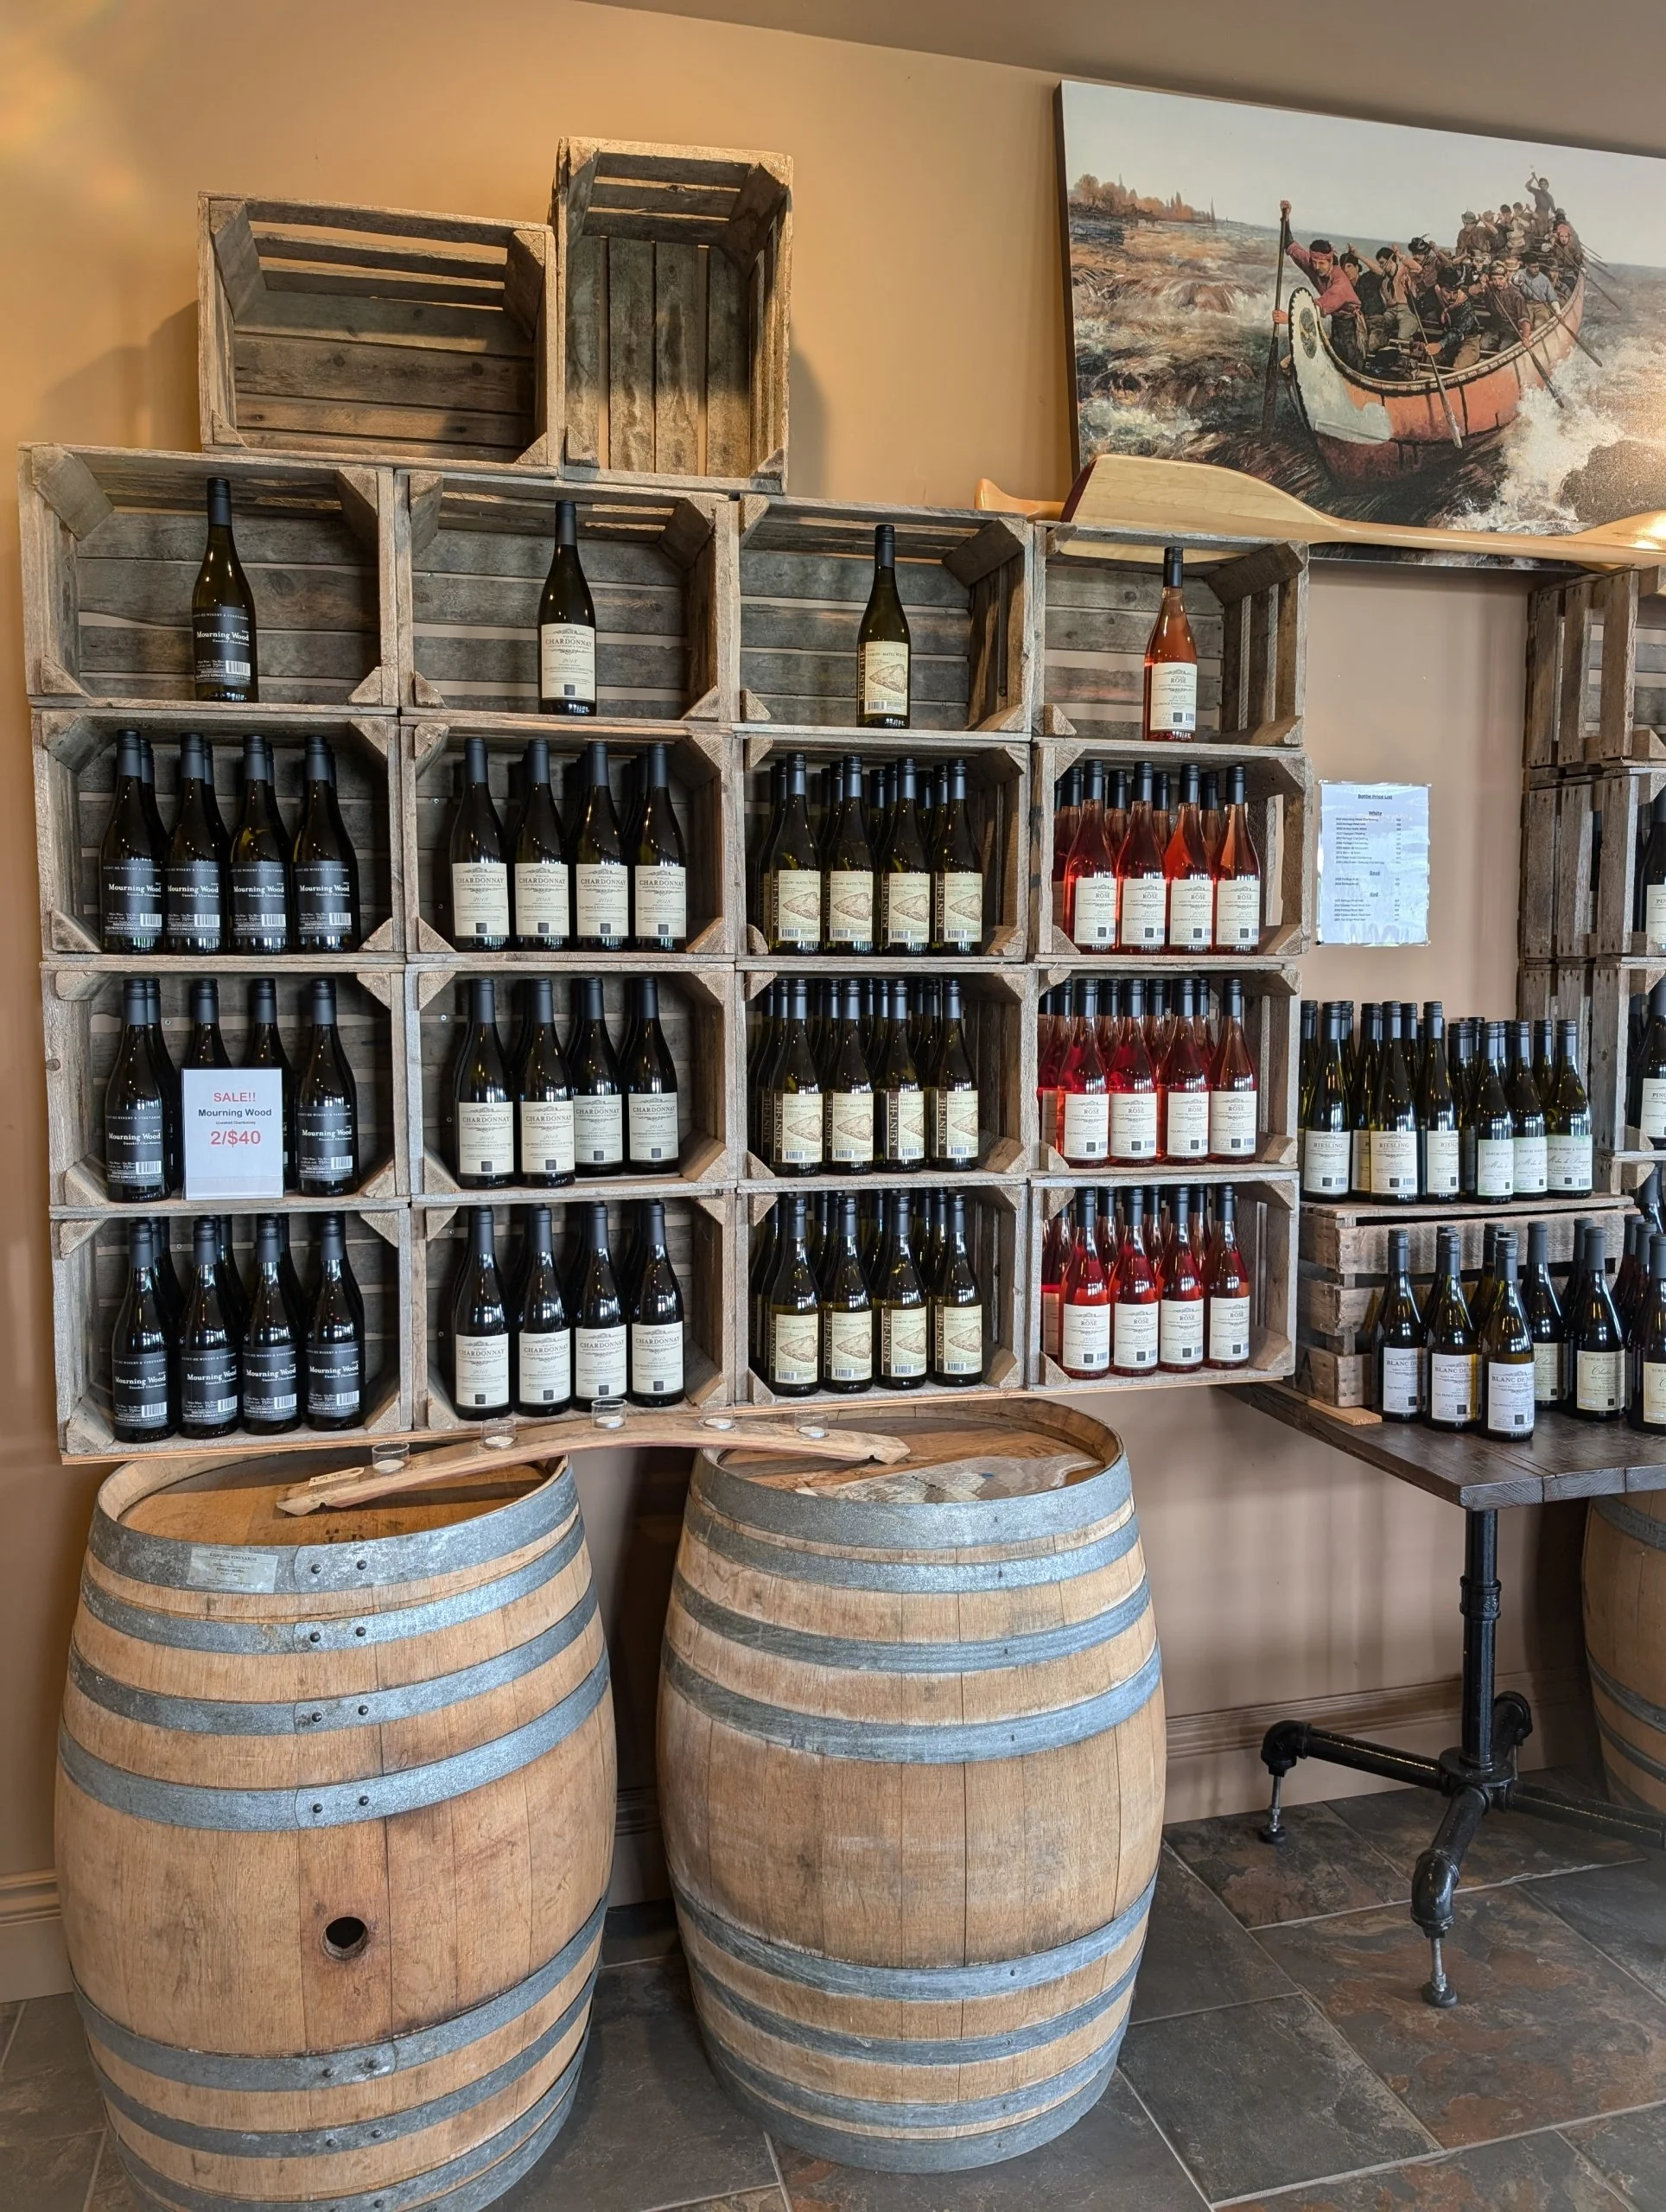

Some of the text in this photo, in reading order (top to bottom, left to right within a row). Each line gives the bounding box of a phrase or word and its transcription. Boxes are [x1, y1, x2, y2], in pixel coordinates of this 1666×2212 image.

[196, 631, 250, 641] Mourning Wood
[545, 638, 593, 647] CHARDONNAY
[108, 883, 145, 893] Mourning
[167, 885, 199, 893] Mourning
[299, 885, 333, 893] Mourning
[213, 1092, 256, 1103] SALE!!
[198, 1109, 243, 1118] Mourning
[889, 1098, 898, 1146] KEINT-HE
[938, 1096, 947, 1144] KEINT-HE
[108, 1132, 141, 1141] Mourning
[210, 1128, 261, 1147] 2/$40
[302, 1128, 352, 1138] Mourning Wood
[580, 1339, 624, 1348] CHARDONNAY
[635, 1336, 680, 1344] CHARDONNAY
[524, 1344, 569, 1353] CHARDONNAY
[222, 1369, 237, 1378] Wood
[245, 1367, 296, 1378] Mourning Wood
[309, 1363, 359, 1375] Mourning Wood
[115, 1376, 146, 1386] Mourning
